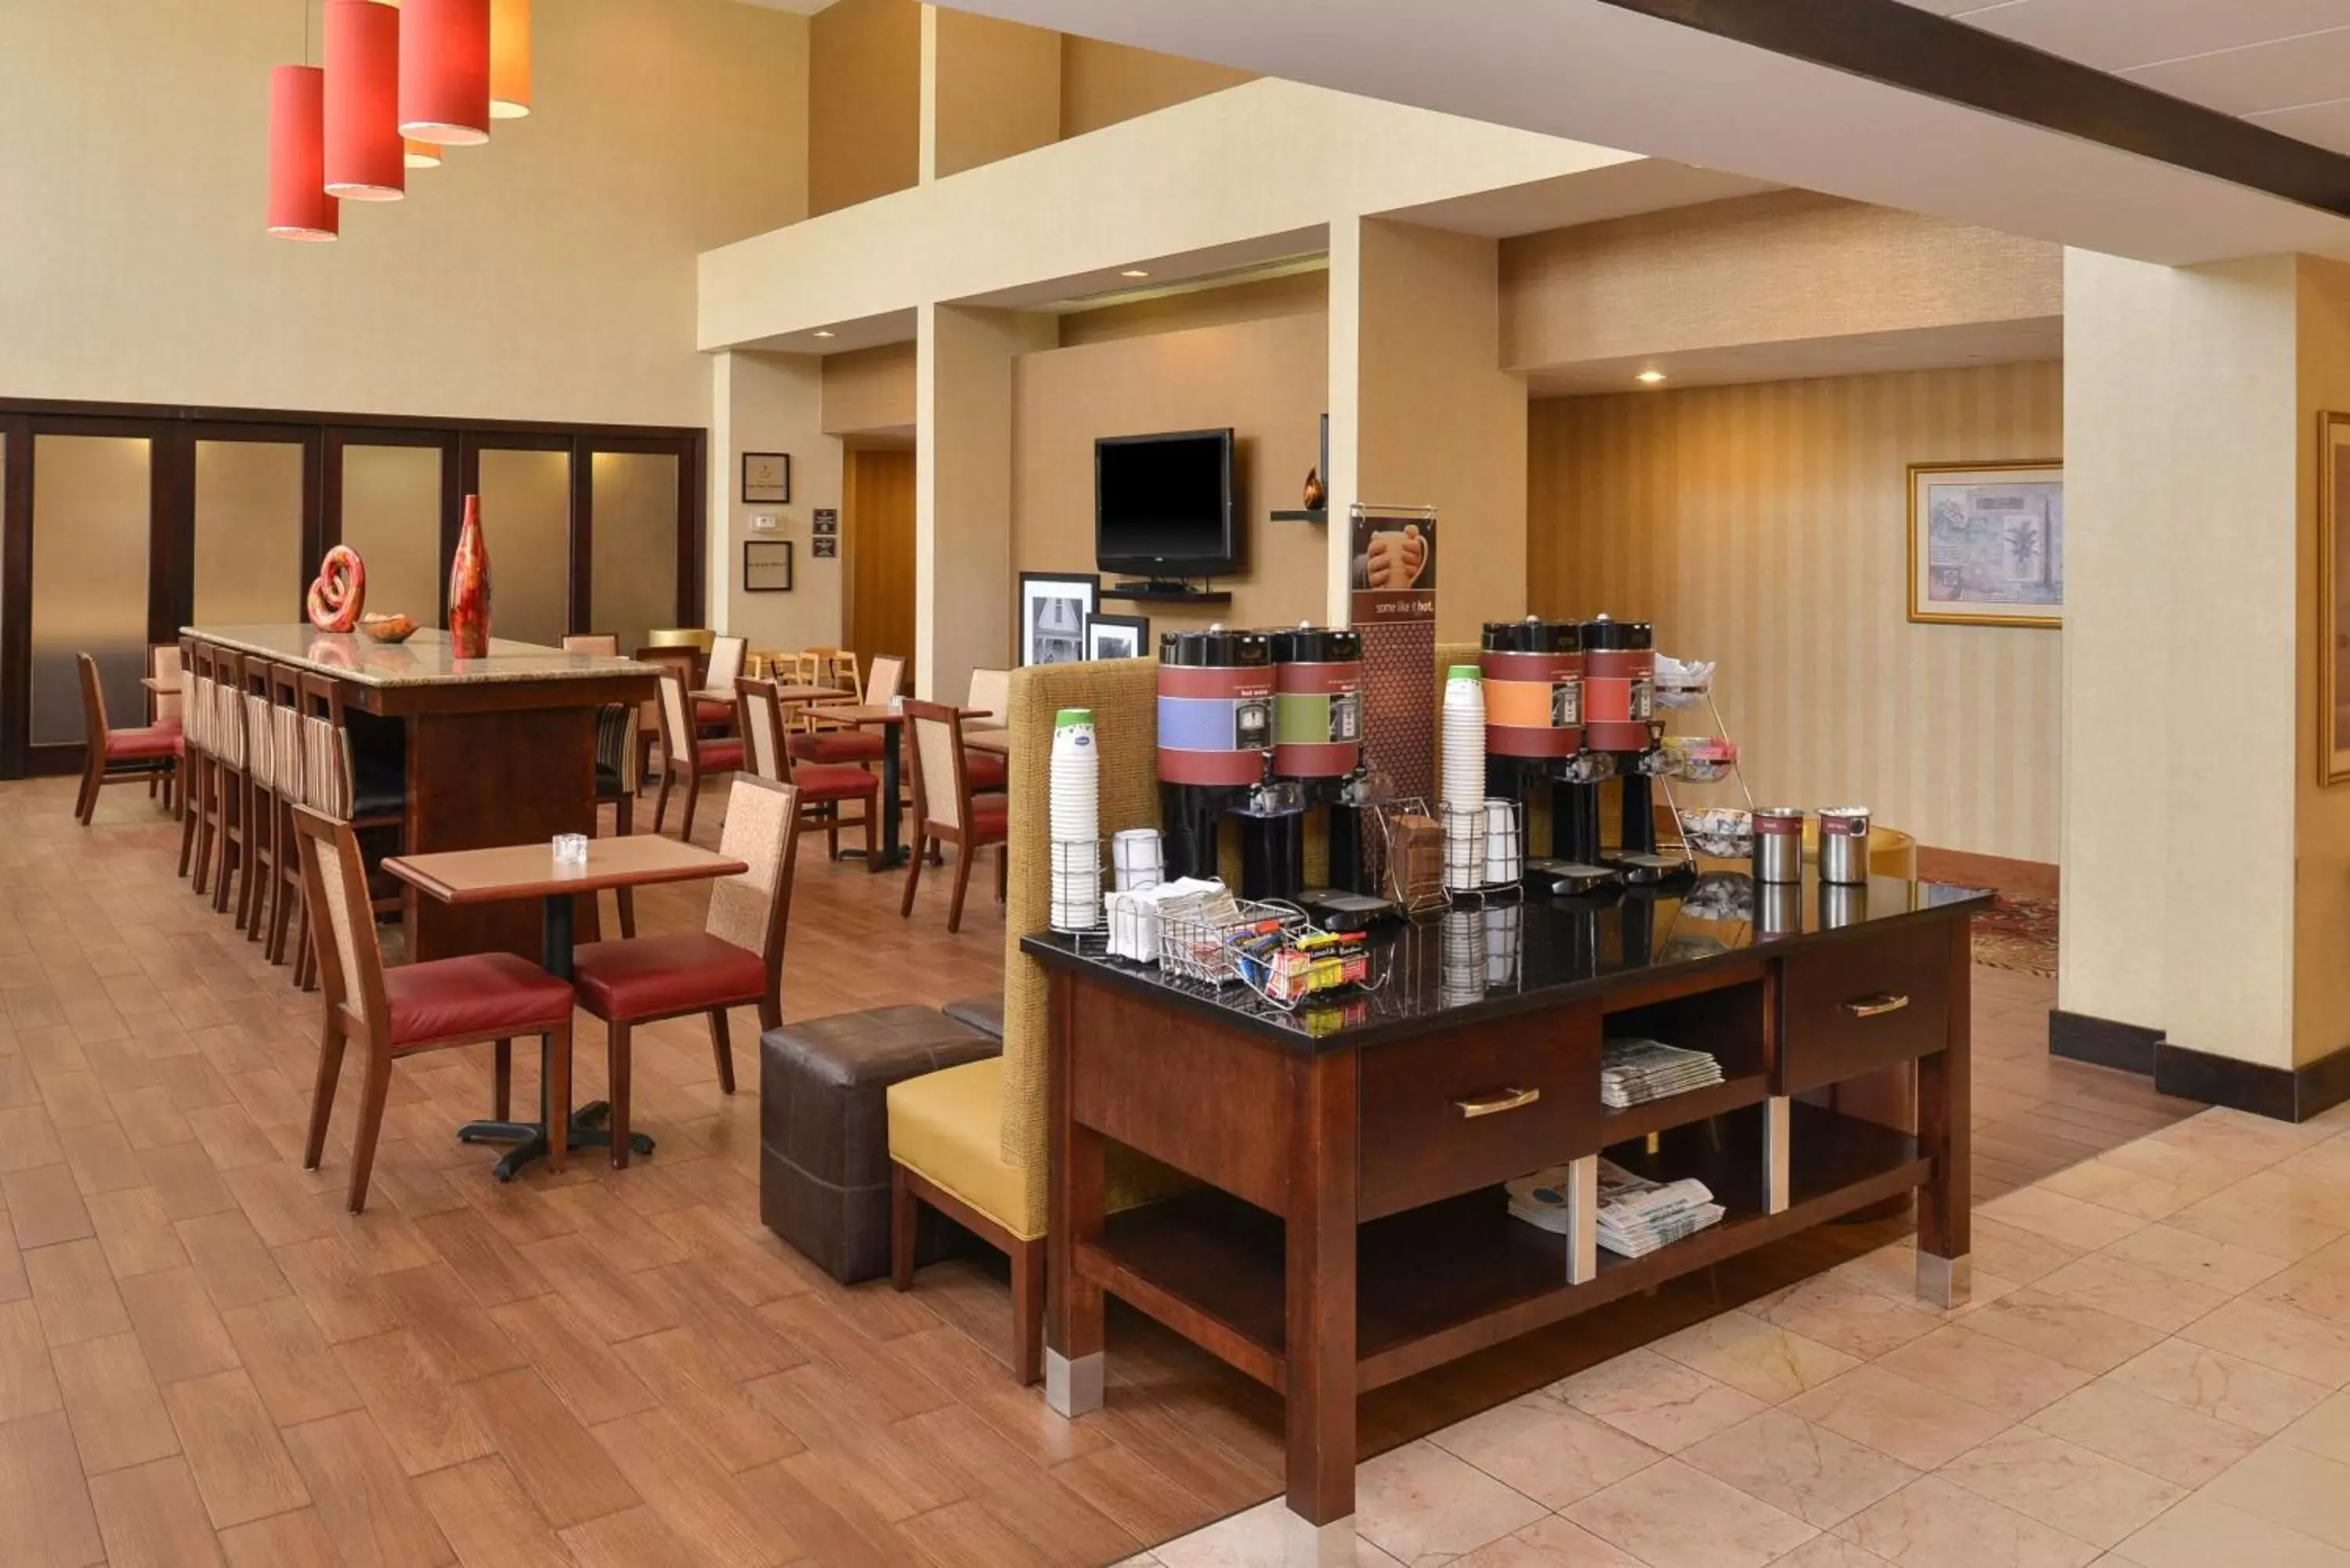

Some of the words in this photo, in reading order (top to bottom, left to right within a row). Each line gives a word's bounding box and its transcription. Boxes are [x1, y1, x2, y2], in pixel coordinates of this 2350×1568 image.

[1376, 602, 1396, 613] some
[1397, 601, 1410, 612] like
[1417, 600, 1434, 612] hot.
